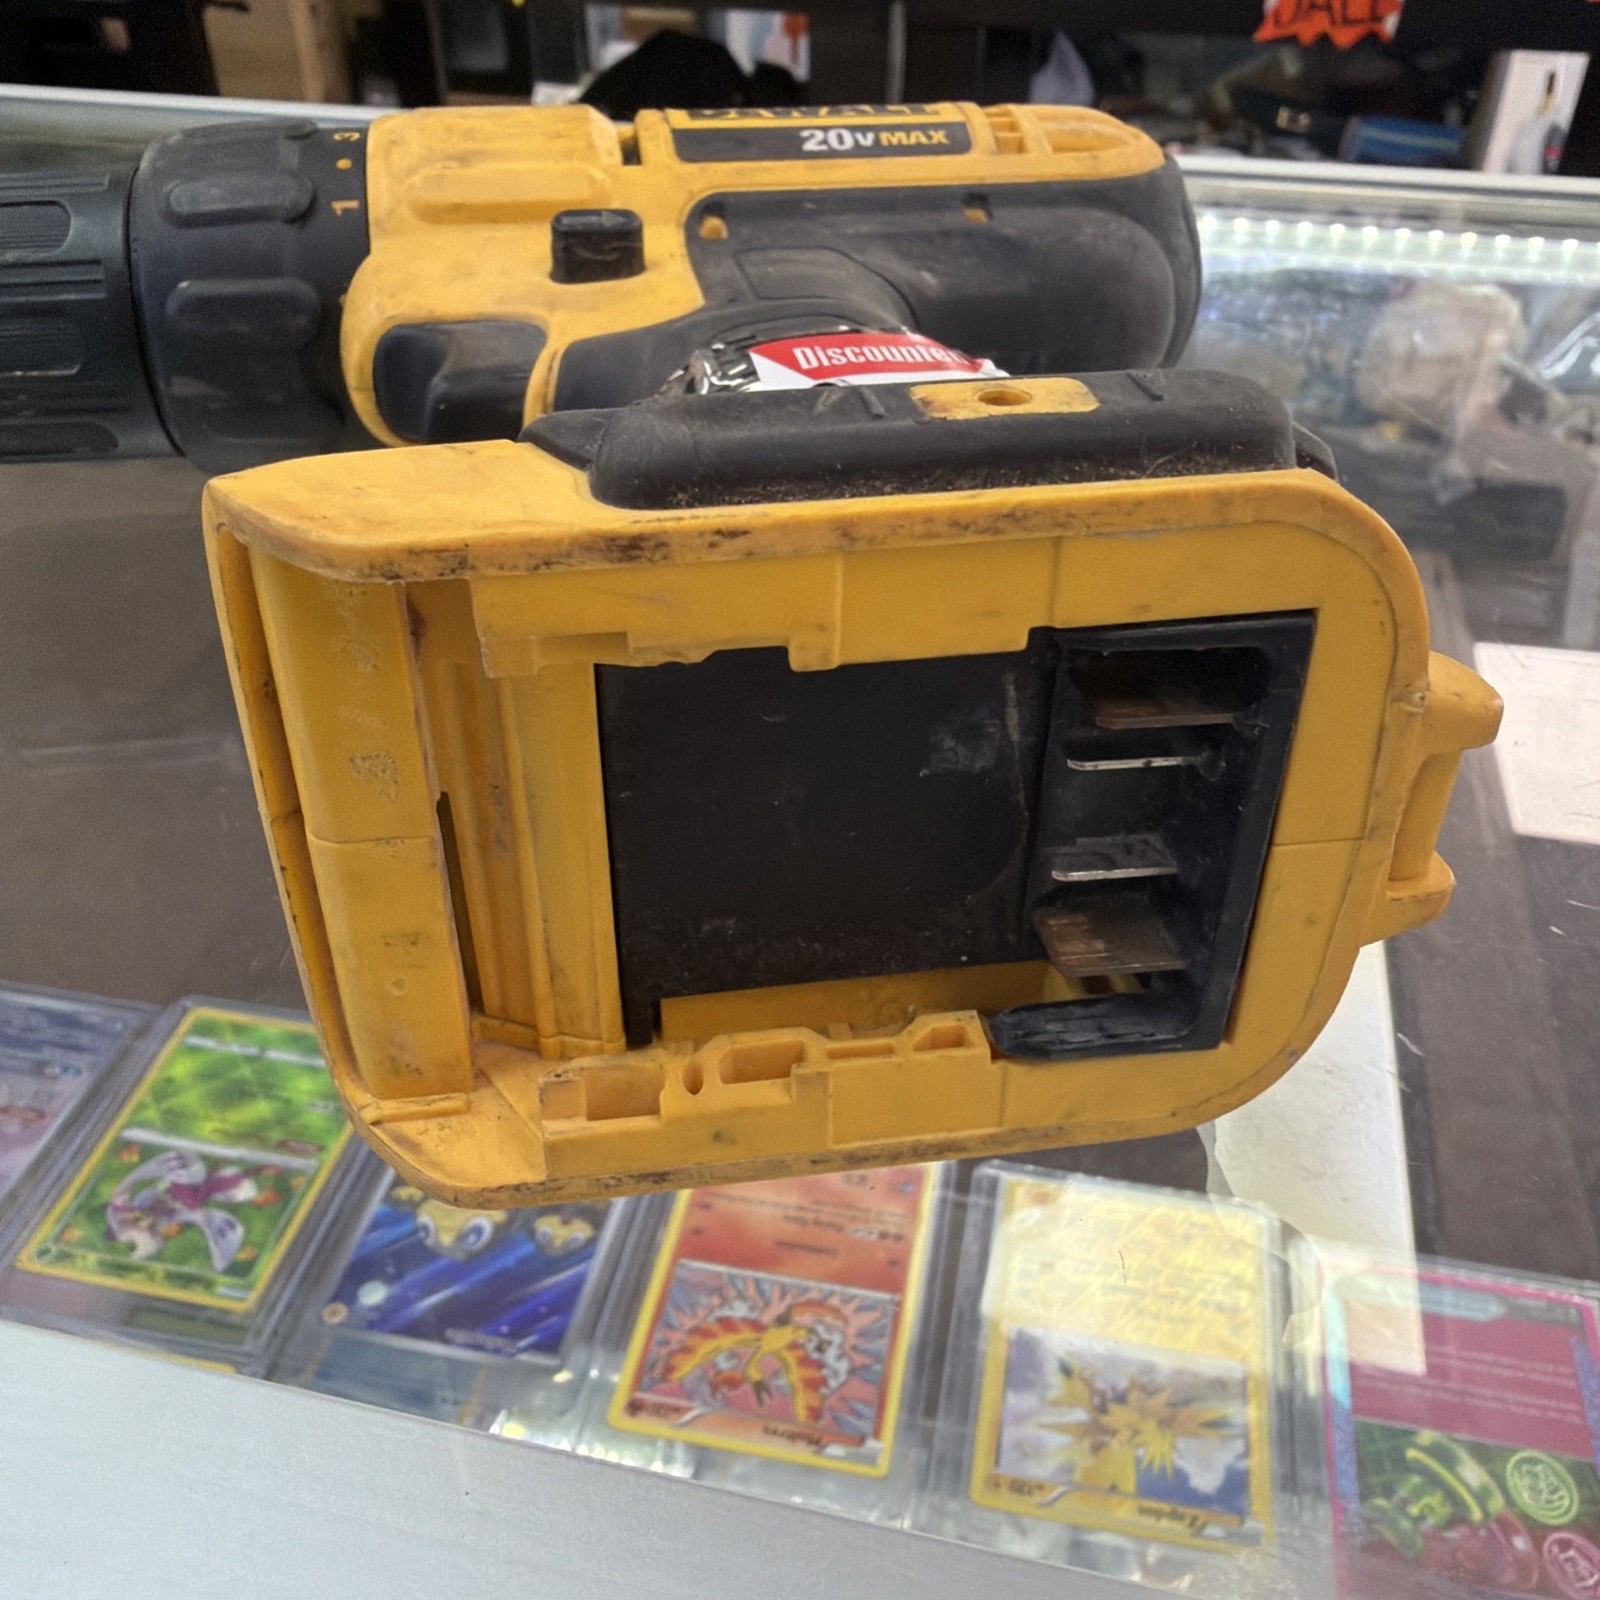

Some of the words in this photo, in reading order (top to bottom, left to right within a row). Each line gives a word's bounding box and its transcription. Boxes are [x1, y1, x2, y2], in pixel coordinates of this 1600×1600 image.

[333, 132, 360, 141] 3
[878, 130, 949, 146] MAX
[331, 200, 359, 217] 1
